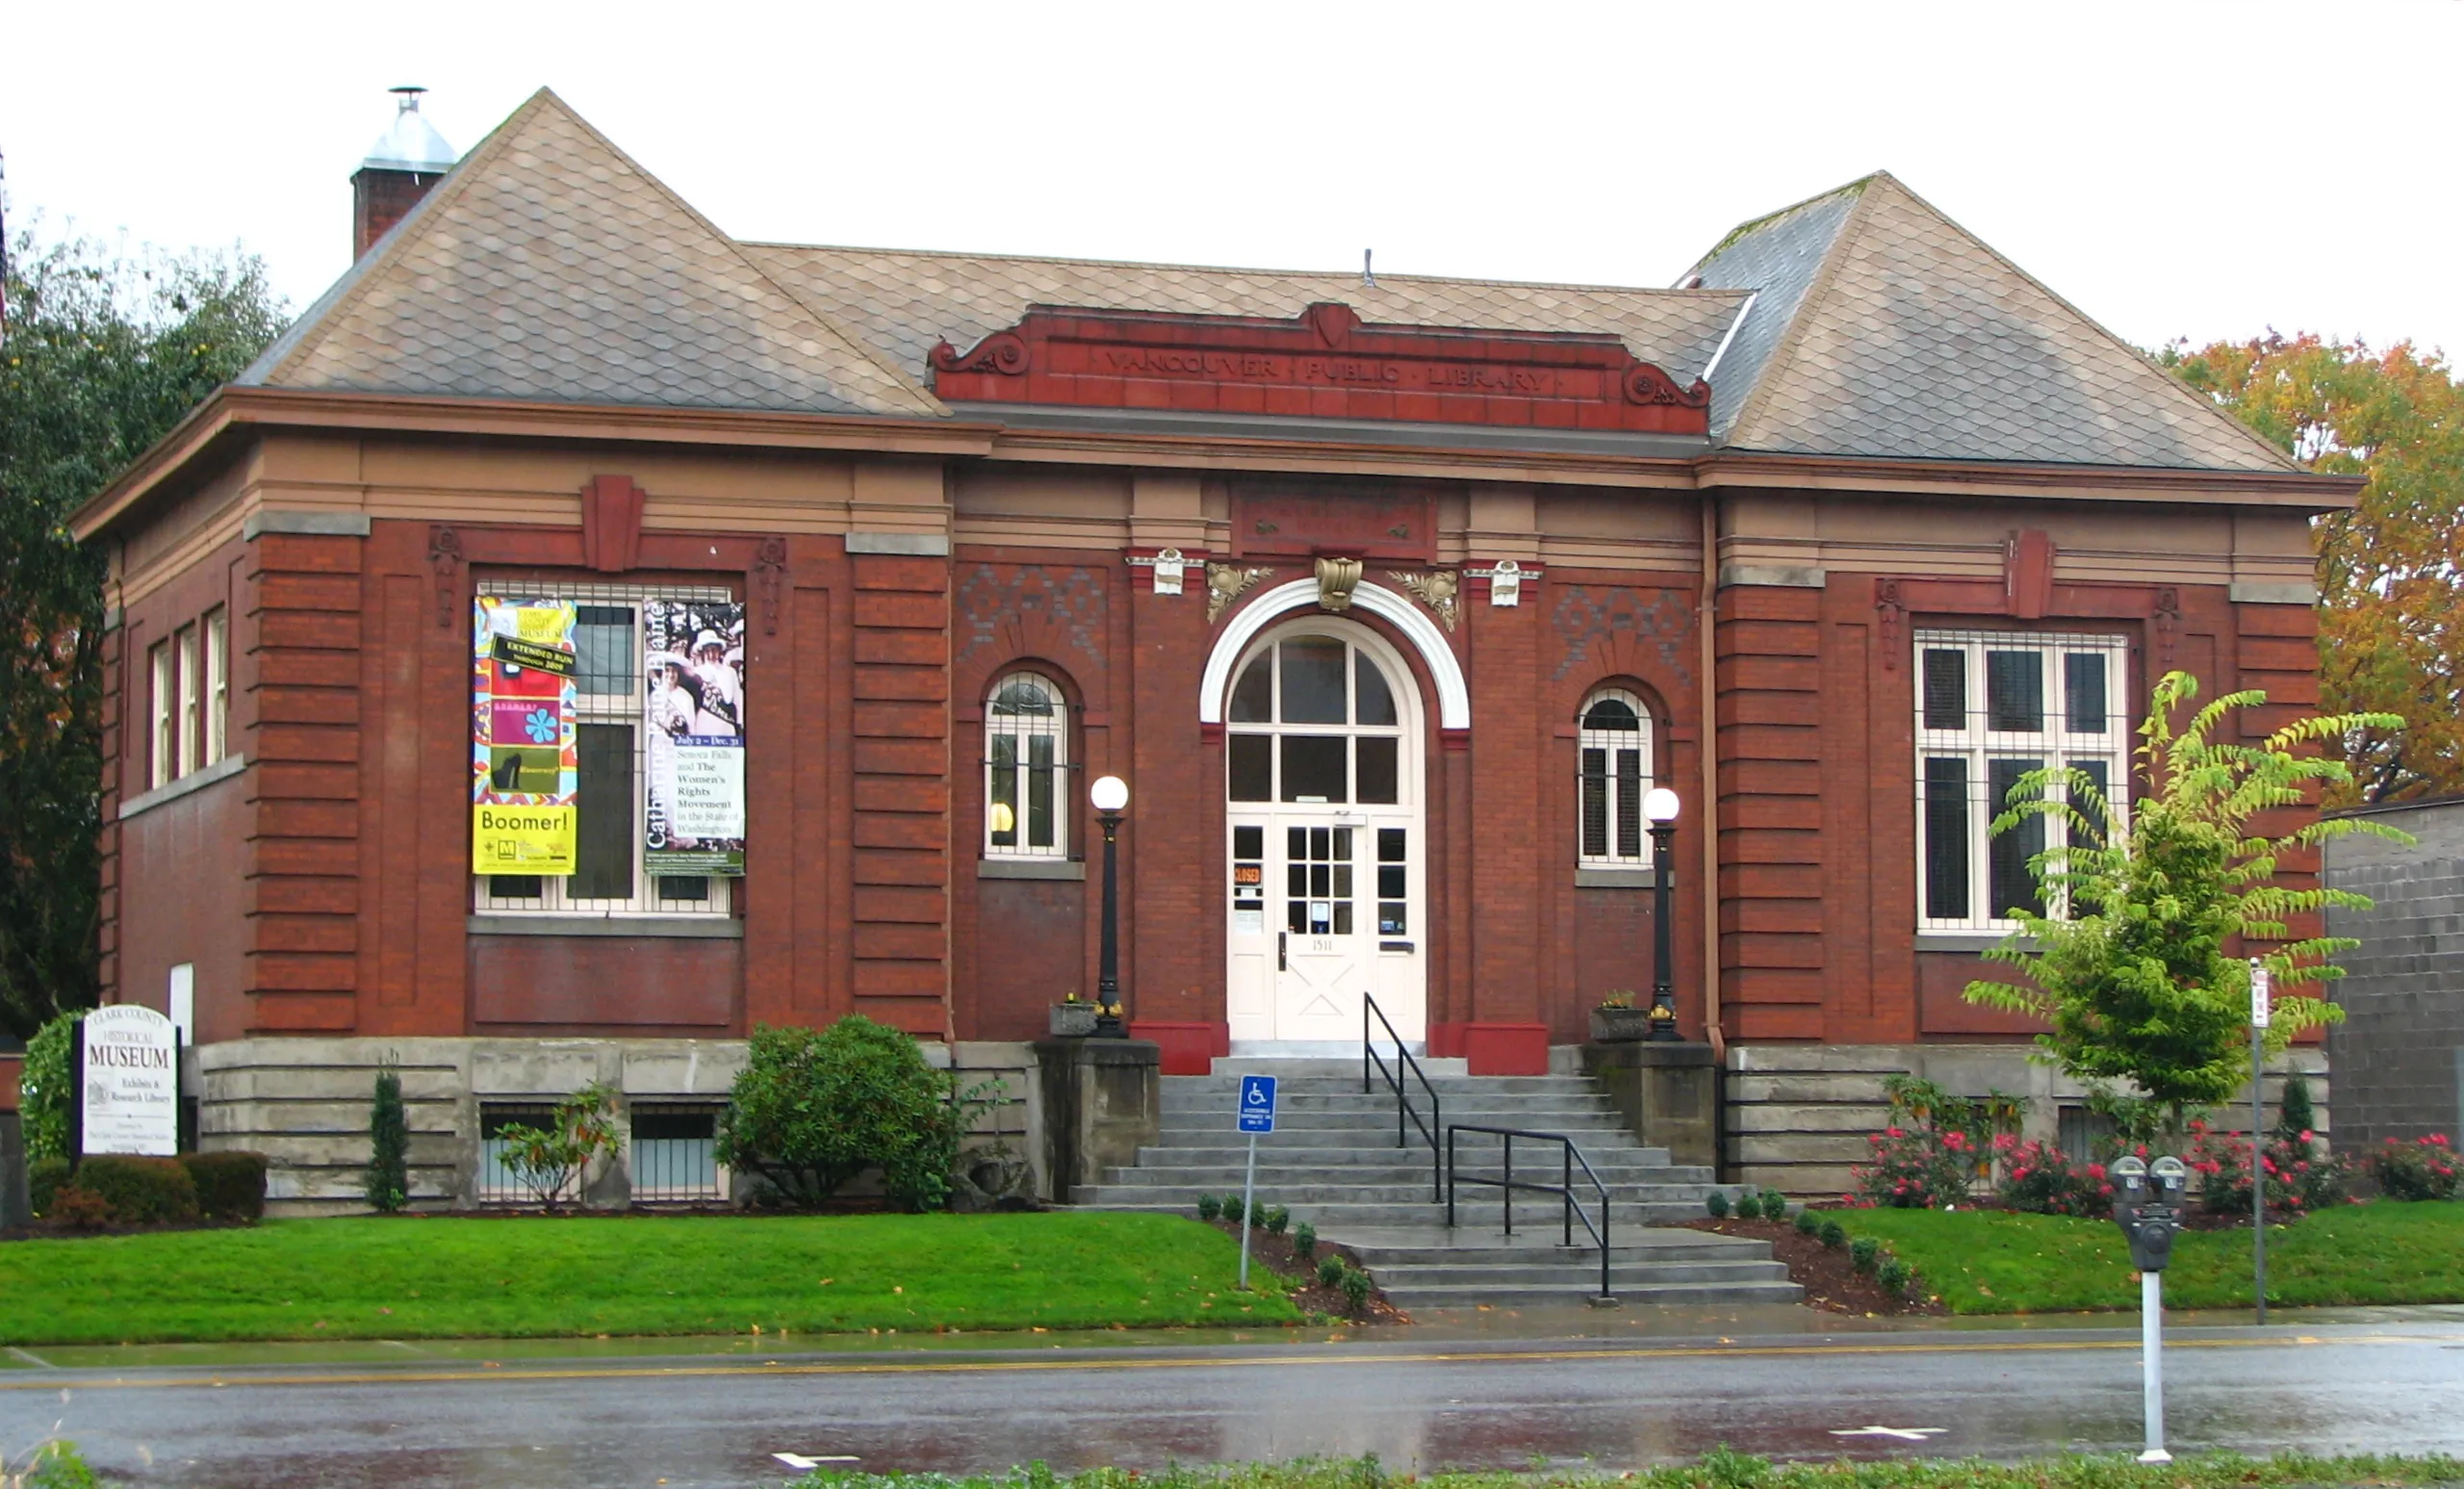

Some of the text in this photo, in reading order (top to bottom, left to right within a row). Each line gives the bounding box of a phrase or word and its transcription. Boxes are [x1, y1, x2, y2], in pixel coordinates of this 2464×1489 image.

[1105, 351, 1547, 391] VANCOUVER PUBLIC LIBRARY
[648, 603, 666, 670] Blaine
[506, 641, 574, 665] EXTENDED RUN
[676, 735, 694, 745] July
[710, 735, 729, 745] Dec.
[711, 750, 732, 759] Falls
[677, 761, 716, 771] and The
[647, 742, 666, 849] Catharine
[678, 786, 711, 798] Rights
[678, 800, 732, 809] Movement
[482, 810, 567, 831] Boomer!
[678, 810, 738, 821] in the State of
[678, 824, 732, 834] Washington
[1235, 867, 1260, 883] CLOSED
[1313, 939, 1332, 951] 1511
[93, 1008, 164, 1028] CLARK COUNTY
[103, 1030, 153, 1044] HISTORICAL
[89, 1044, 168, 1069] MUSEUM
[121, 1077, 160, 1089] Exhibits &
[111, 1091, 170, 1104] Research Library
